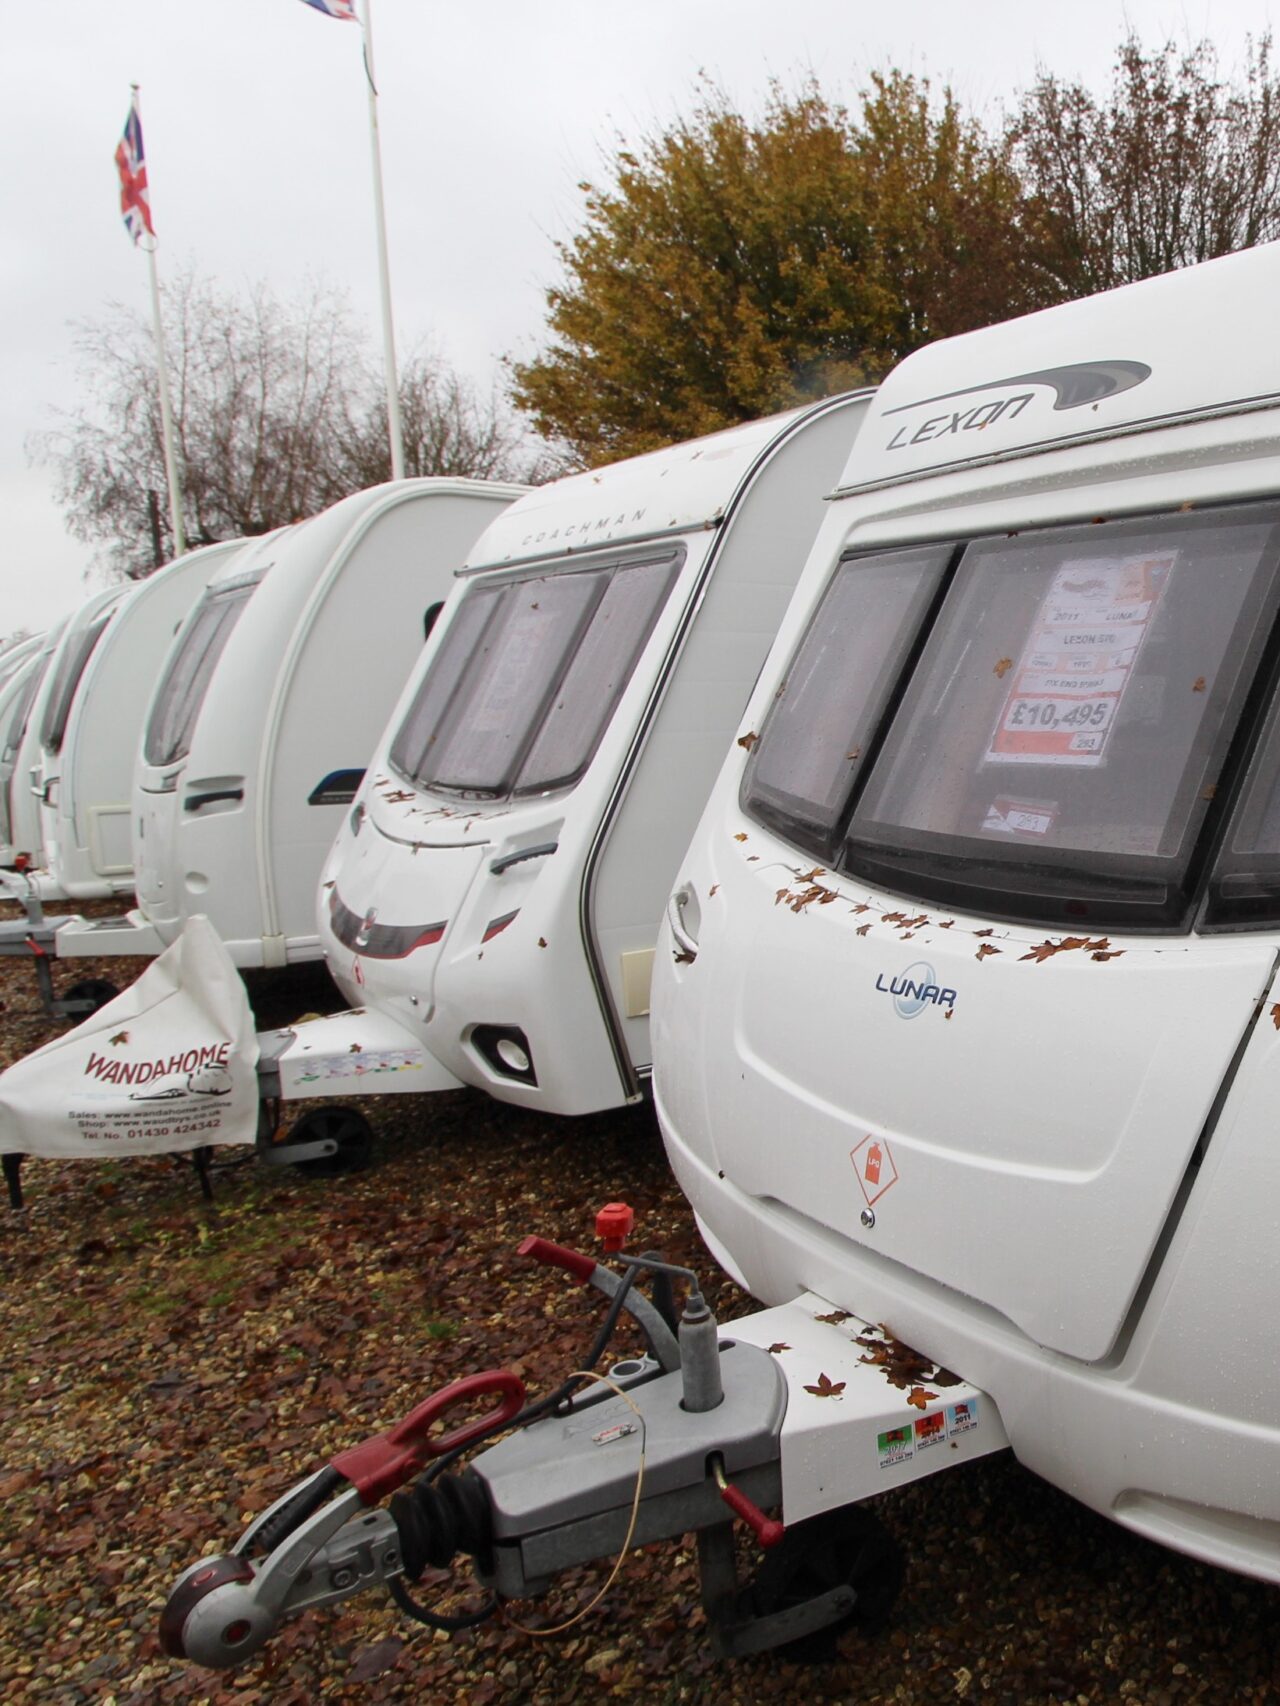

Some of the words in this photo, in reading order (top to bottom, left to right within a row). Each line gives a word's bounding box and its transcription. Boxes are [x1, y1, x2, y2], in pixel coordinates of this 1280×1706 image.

[521, 507, 647, 546] COACHMAN
[1010, 702, 1109, 730] £10,495
[875, 973, 958, 1008] LUNAR
[84, 1042, 232, 1086] WANDAHOME
[127, 1126, 170, 1139] 01430
[173, 1118, 222, 1135] 424342
[954, 1413, 971, 1425] 2011
